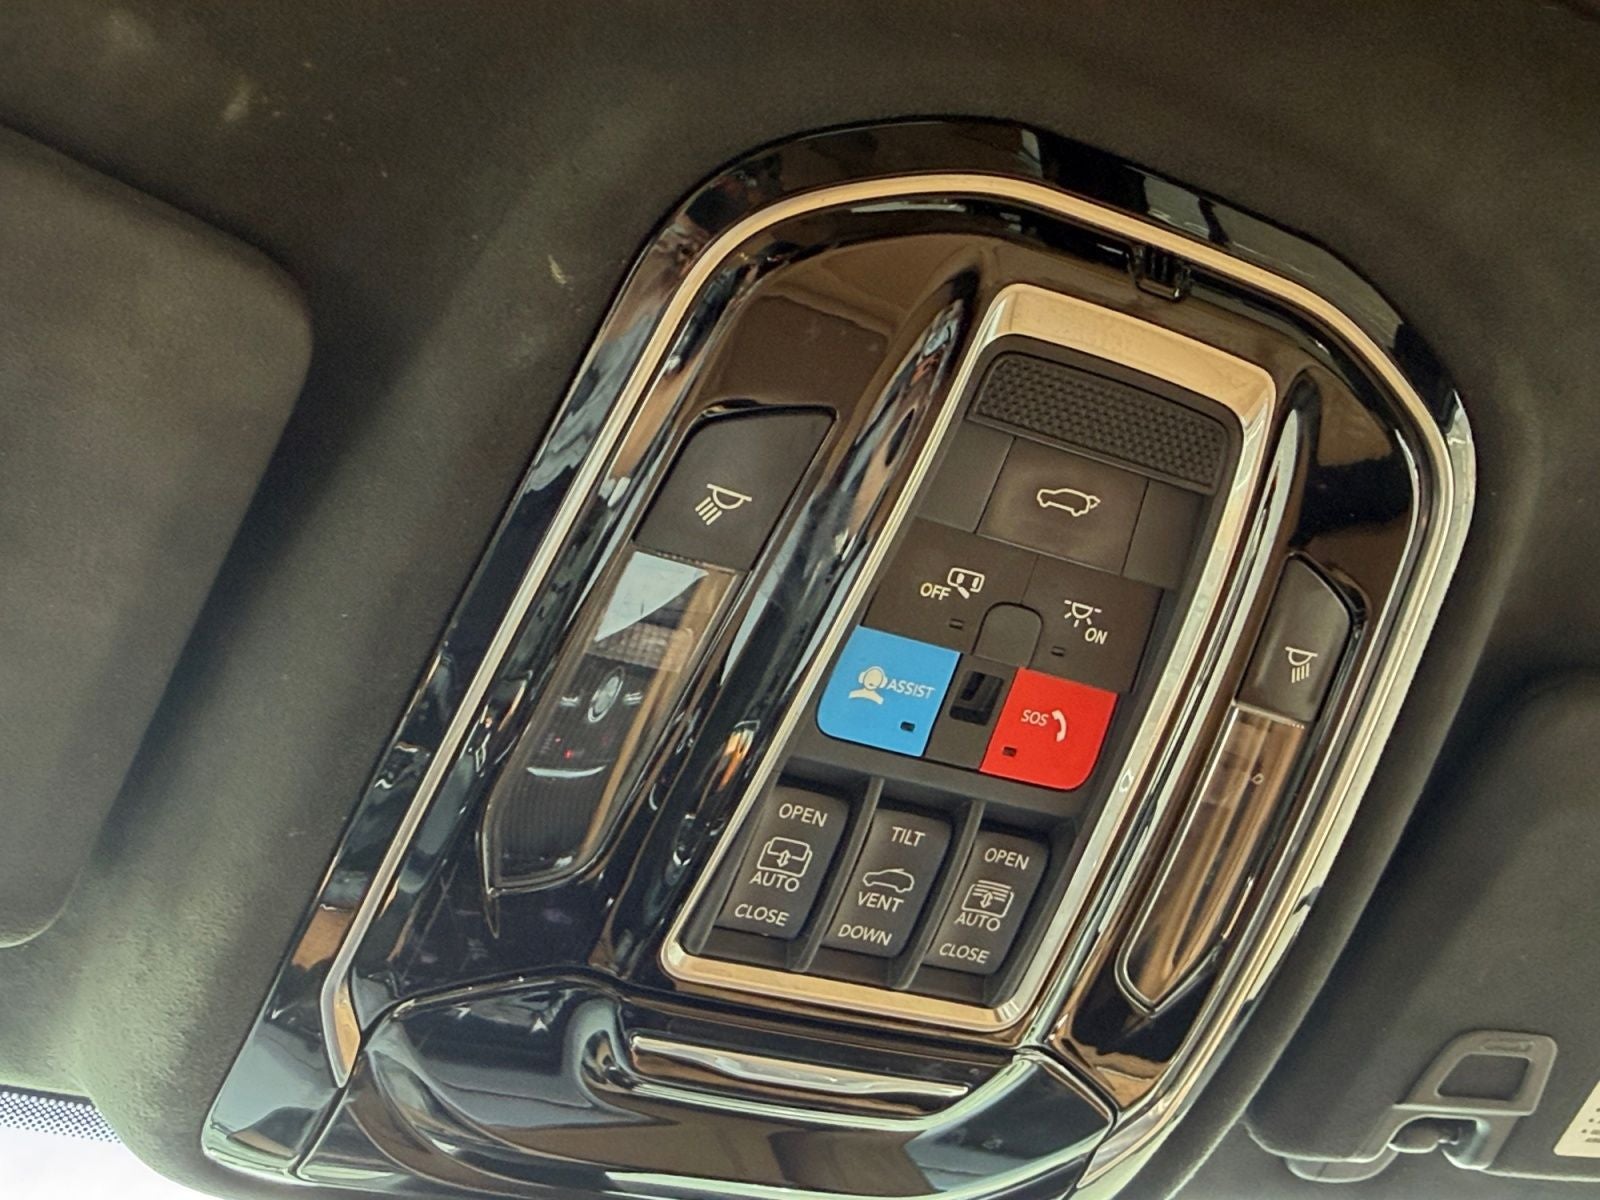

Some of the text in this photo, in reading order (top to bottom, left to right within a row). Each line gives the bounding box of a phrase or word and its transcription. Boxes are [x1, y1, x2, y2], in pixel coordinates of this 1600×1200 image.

[920, 583, 951, 601] OFF
[1084, 627, 1108, 645] ON
[886, 679, 935, 700] ASSIST
[1020, 709, 1050, 727] SOS
[778, 803, 828, 828] OPEN
[891, 826, 926, 848] TILT
[984, 848, 1031, 871] OPEN
[749, 871, 800, 893] AUTO
[857, 891, 904, 913] VENT
[734, 903, 790, 927] CLOSE
[954, 911, 1001, 932] AUTO
[838, 924, 893, 946] DOWN
[939, 943, 990, 964] CLOSE
